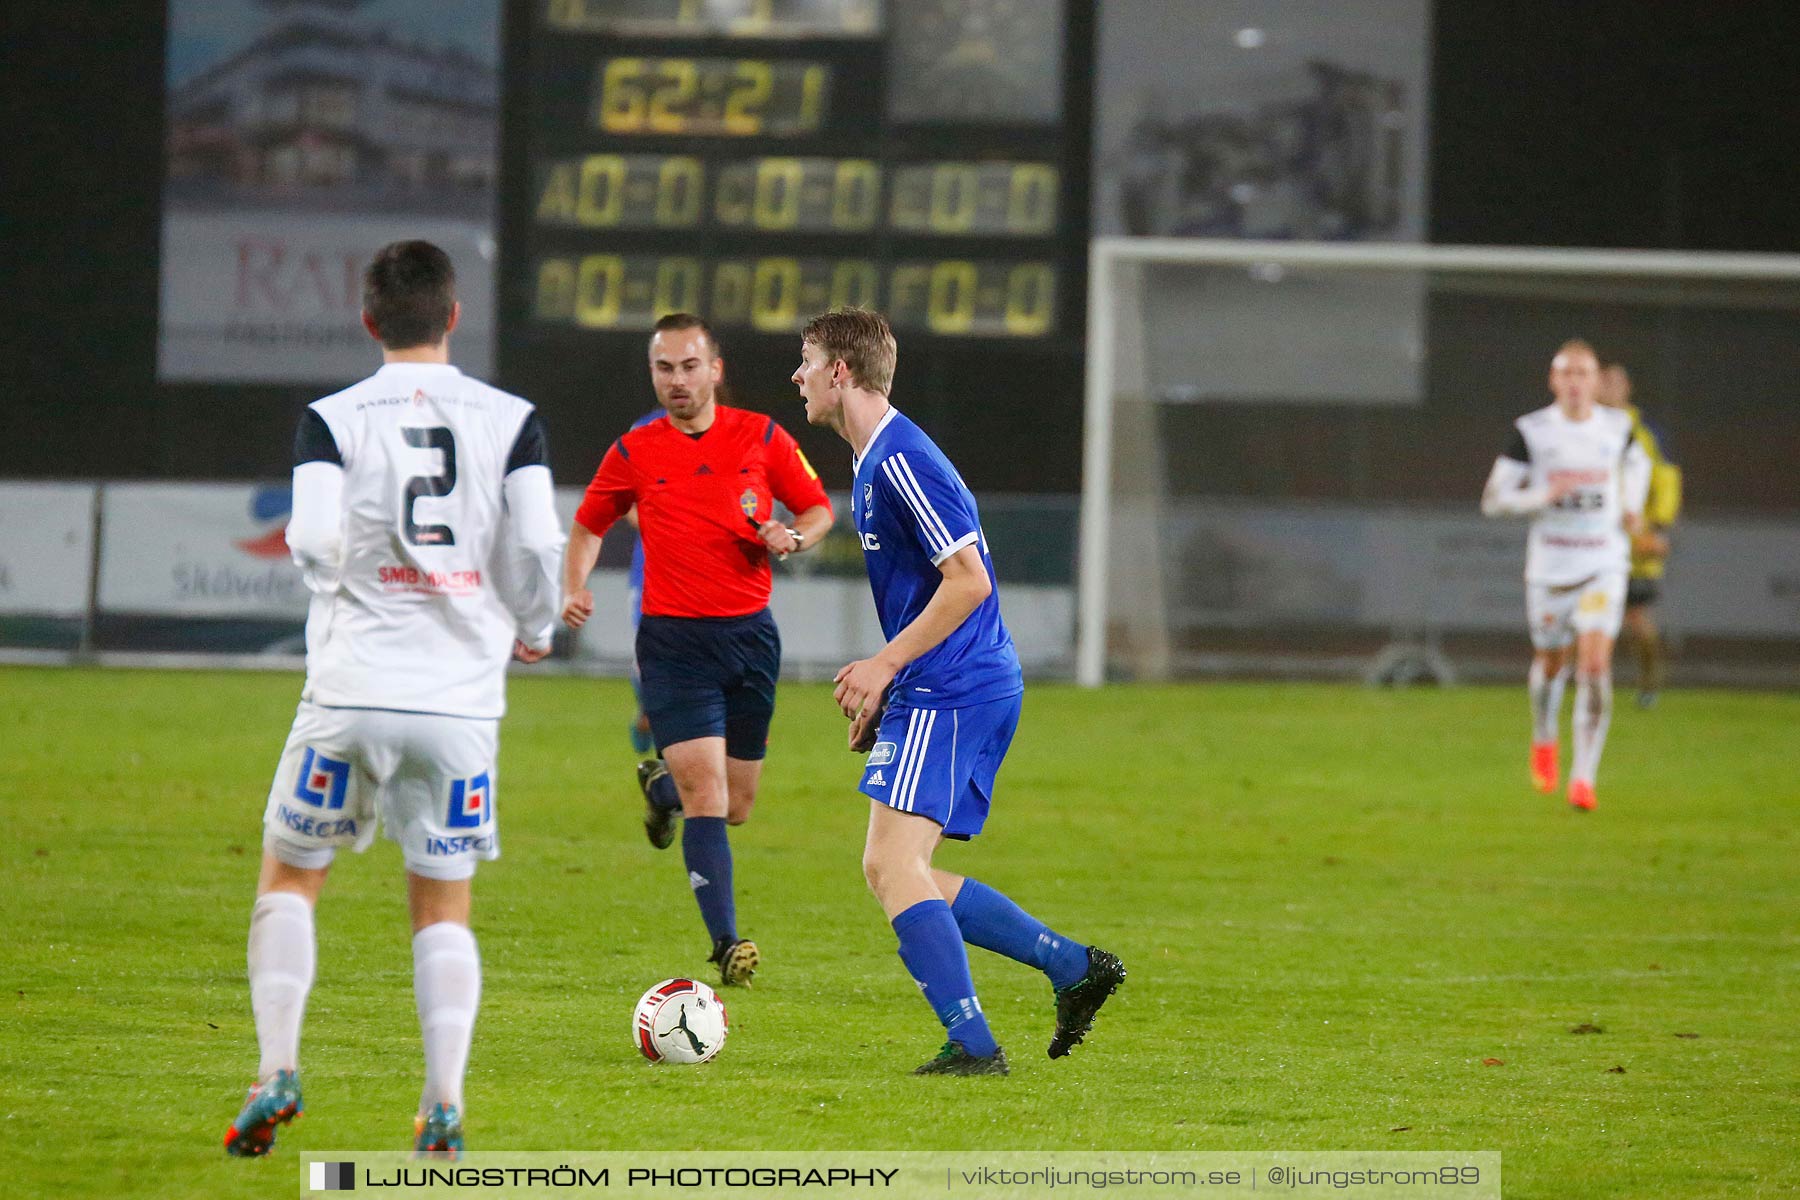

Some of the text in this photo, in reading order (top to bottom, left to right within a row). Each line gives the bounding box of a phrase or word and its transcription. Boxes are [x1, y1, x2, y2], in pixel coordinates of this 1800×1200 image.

[400, 426, 456, 547] 2
[379, 566, 418, 584] SMB
[278, 803, 358, 838] INSECTA
